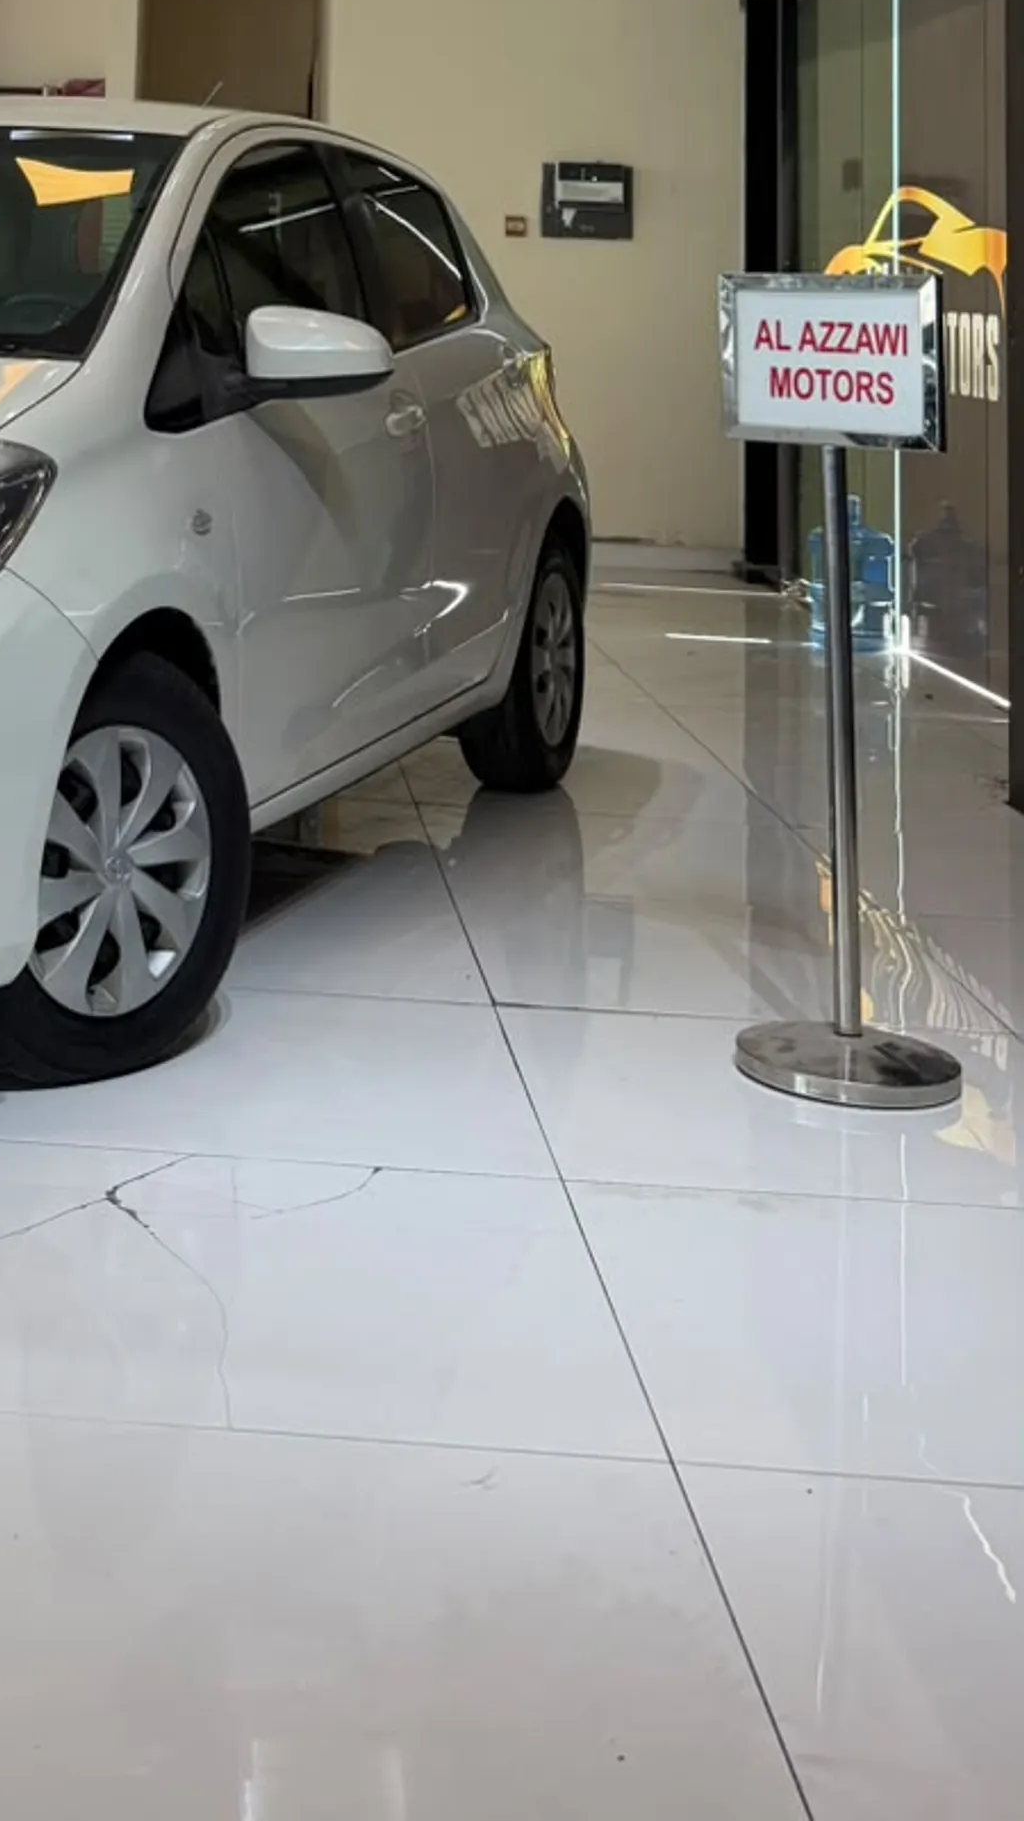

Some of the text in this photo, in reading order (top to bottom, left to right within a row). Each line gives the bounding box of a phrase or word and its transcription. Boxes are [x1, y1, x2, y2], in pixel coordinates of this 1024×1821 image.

[754, 319, 908, 357] AL AZZAWI
[943, 310, 1000, 402] TORS
[769, 366, 894, 406] MOTORS
